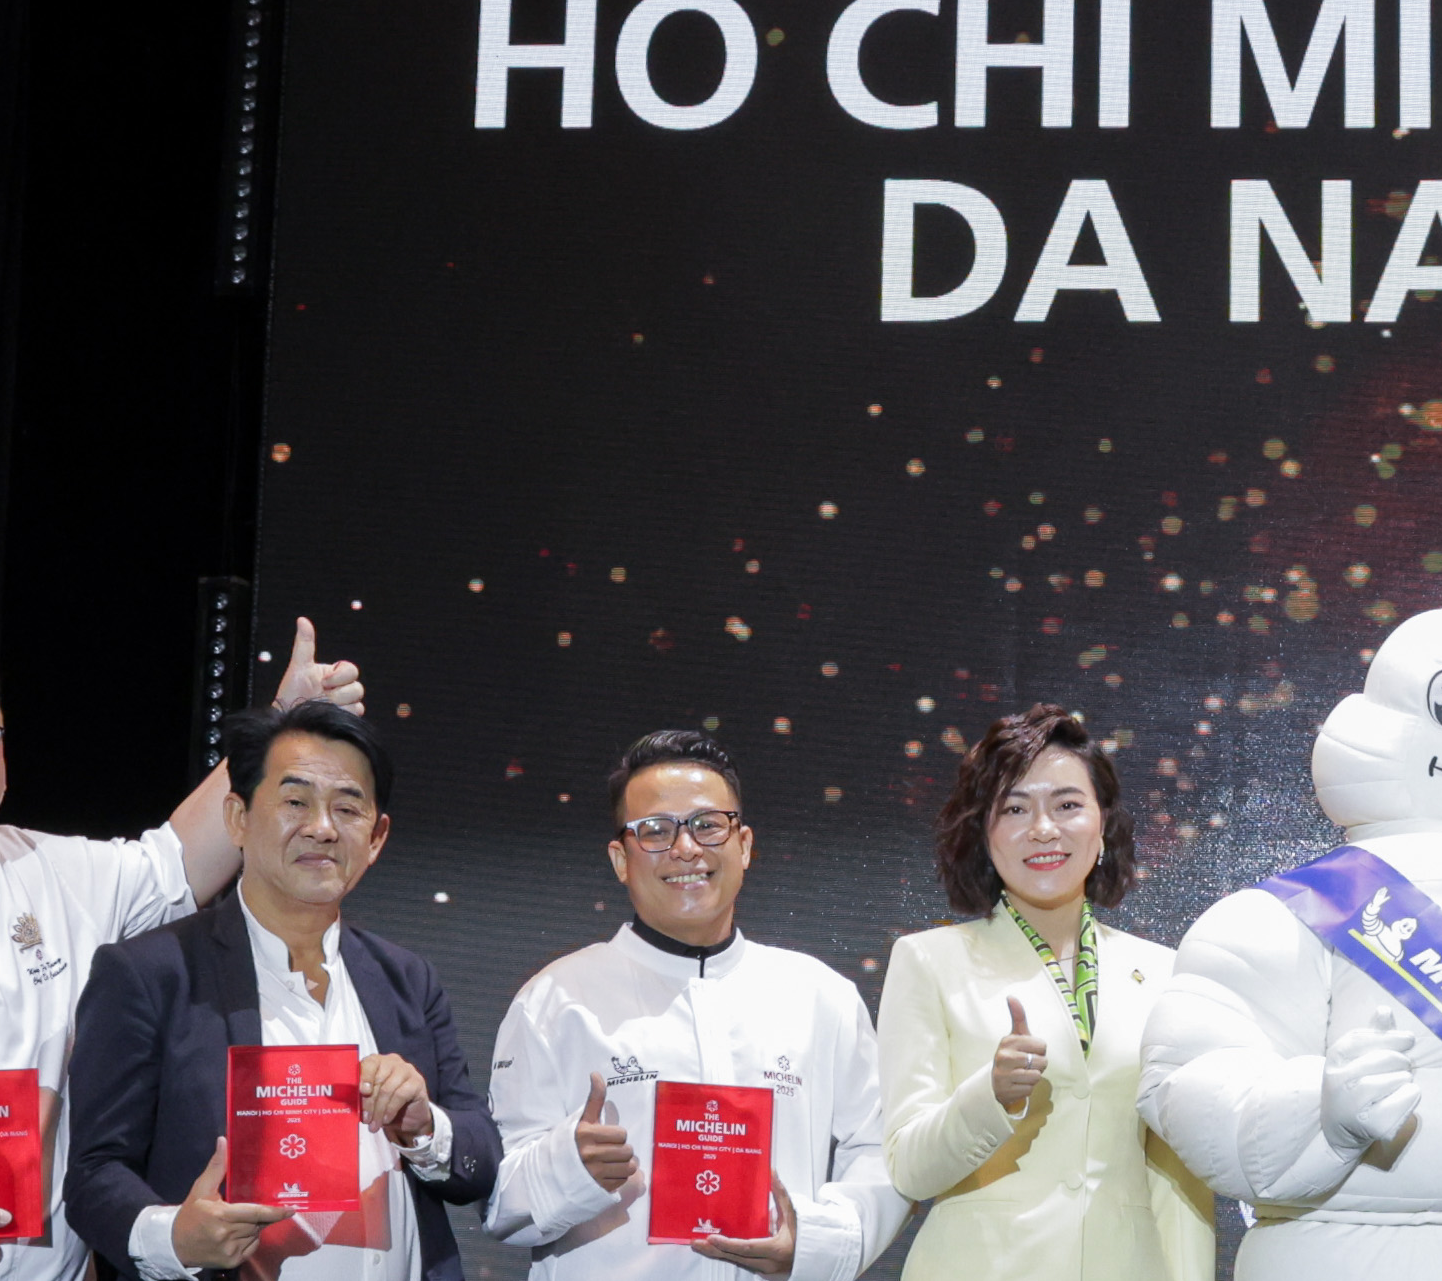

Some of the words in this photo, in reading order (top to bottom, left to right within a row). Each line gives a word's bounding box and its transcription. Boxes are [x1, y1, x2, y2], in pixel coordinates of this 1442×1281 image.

[880, 178, 1163, 324] DA
[607, 1073, 658, 1087] MICHELIN
[764, 1071, 802, 1086] MICHELIN
[256, 1085, 332, 1098] MICHELIN
[776, 1084, 794, 1097] 2025
[676, 1119, 746, 1135] MICHELIN
[698, 1134, 723, 1142] GUIDE
